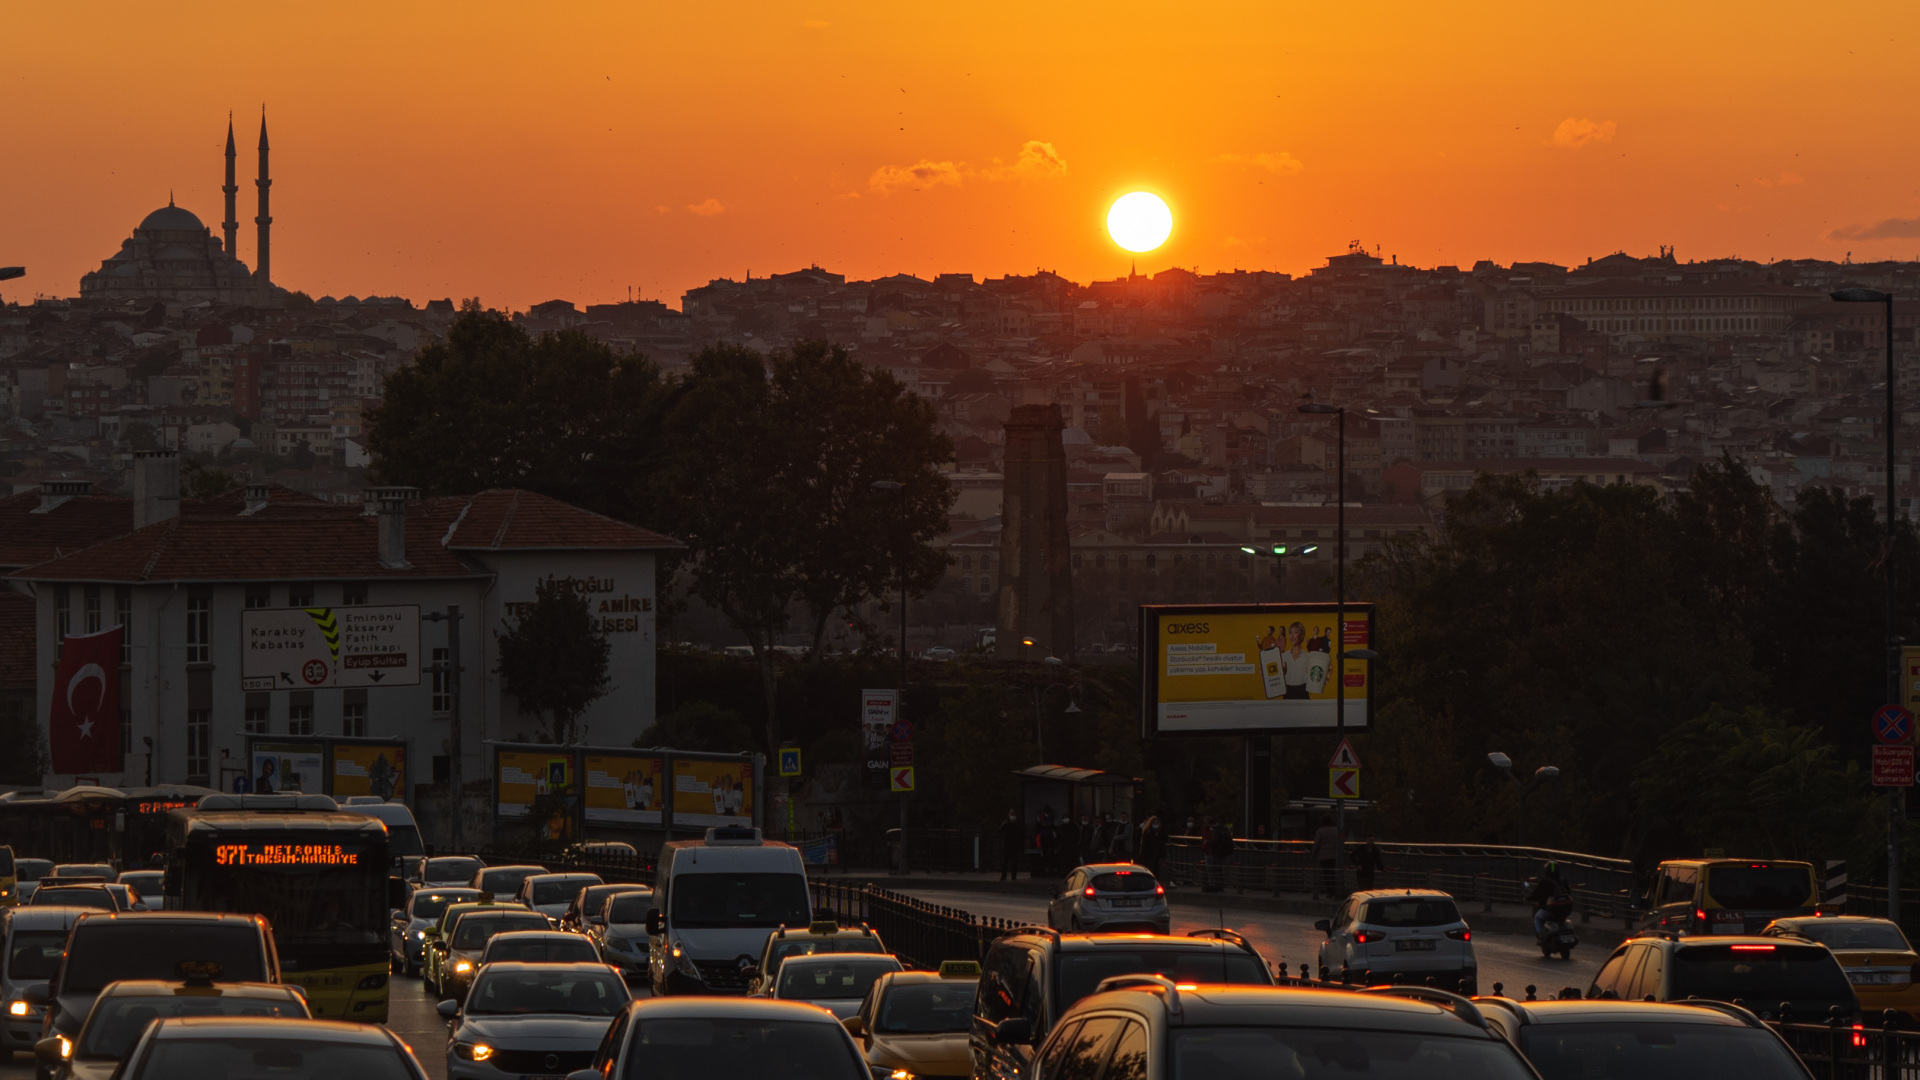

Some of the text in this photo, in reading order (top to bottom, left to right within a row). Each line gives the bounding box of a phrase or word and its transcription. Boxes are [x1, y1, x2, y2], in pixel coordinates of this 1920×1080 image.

[598, 594, 652, 613] AMİRE
[346, 613, 403, 622] Eminönü
[251, 627, 306, 638] Karaköy
[346, 624, 396, 634] Aksaray
[1167, 622, 1210, 635] axess
[346, 634, 377, 643] Fatih
[251, 641, 306, 651] Kabataş
[346, 645, 400, 655] Yenikapı
[347, 656, 405, 668] Eyüp Sultan
[867, 760, 889, 769] GAIN
[216, 845, 248, 865] 97T
